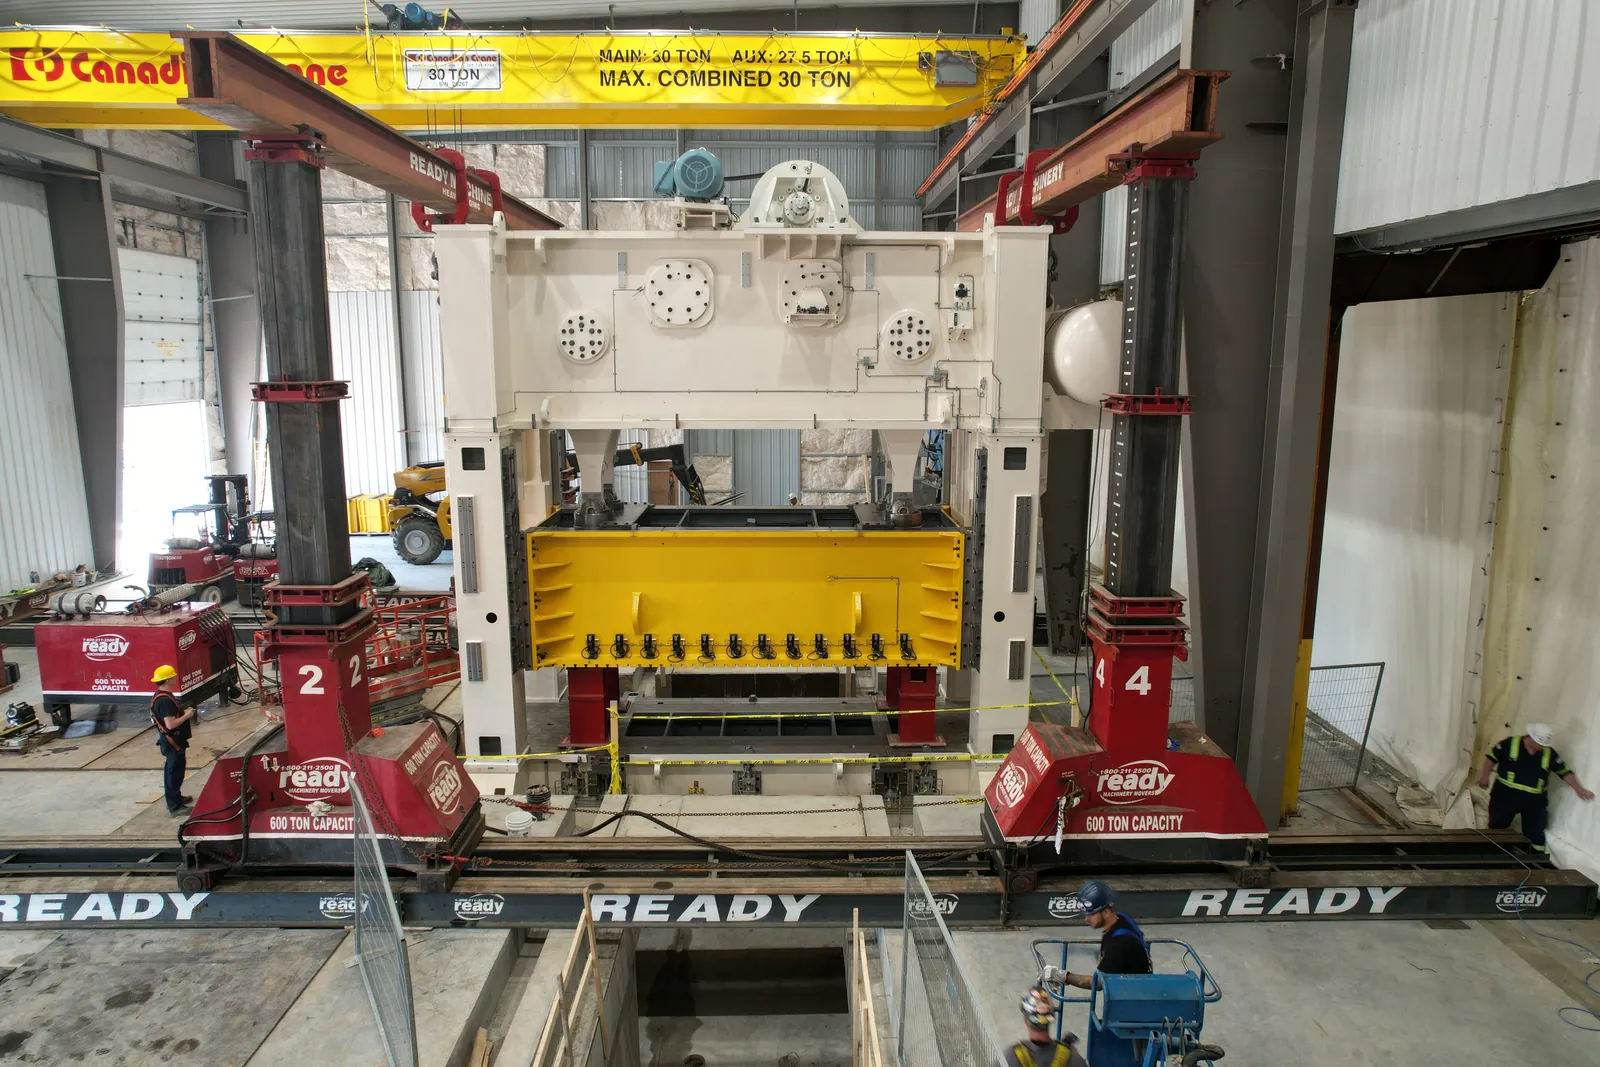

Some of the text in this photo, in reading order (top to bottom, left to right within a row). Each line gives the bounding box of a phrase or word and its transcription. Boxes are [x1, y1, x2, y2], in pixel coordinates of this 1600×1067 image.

[471, 54, 497, 62] Crane
[599, 49, 647, 62] MAIN:
[653, 49, 671, 62] 30
[676, 49, 711, 62] TON
[732, 49, 773, 63] AUX:
[815, 51, 851, 64] TON
[429, 69, 480, 80] 30 TON
[599, 69, 851, 87] MAX. COMBINED 30 TON
[410, 151, 448, 185] READY
[82, 638, 130, 656] ready
[298, 664, 325, 695] 2
[349, 654, 362, 688] 2
[1096, 658, 1105, 688] 4
[1125, 665, 1152, 696] 4
[279, 764, 356, 793] ready
[1097, 767, 1176, 796] ready
[1100, 767, 1151, 775] 1-800-211-2500
[429, 764, 461, 810] ready
[1000, 764, 1025, 808] ready
[270, 816, 355, 831] 600 TON CAPACIT
[1086, 814, 1184, 832] 600 TON CAPACITY
[454, 899, 504, 915] ready
[590, 894, 822, 922] READY
[1181, 886, 1408, 916] READY
[1495, 891, 1547, 907] ready
